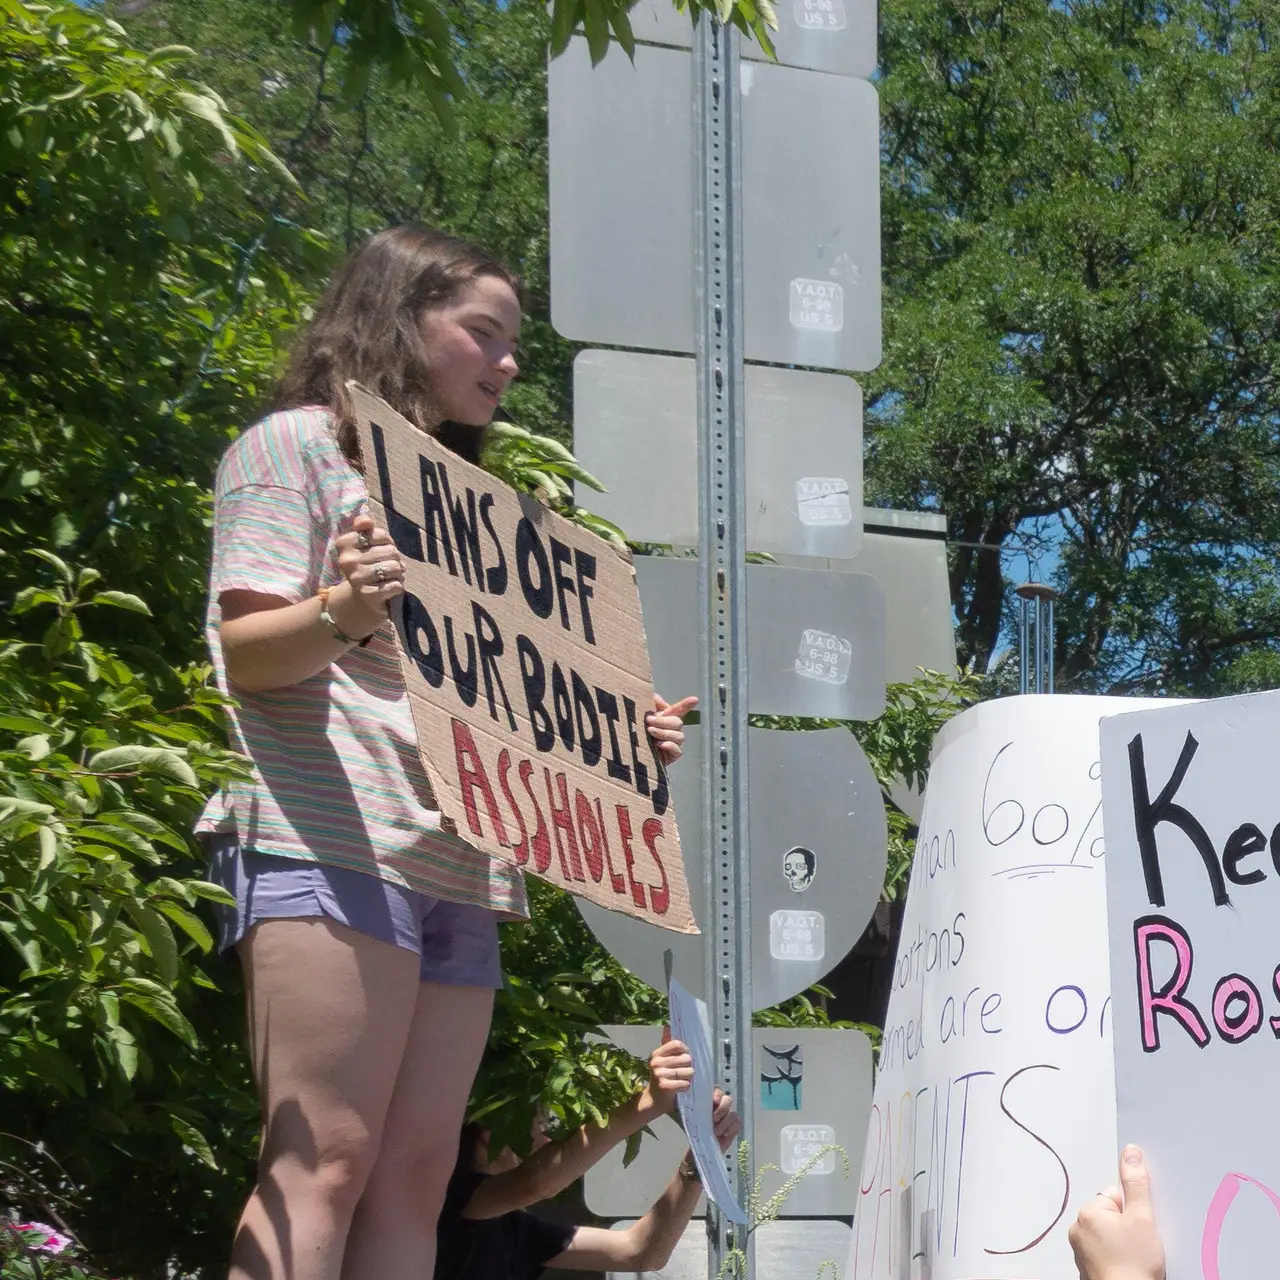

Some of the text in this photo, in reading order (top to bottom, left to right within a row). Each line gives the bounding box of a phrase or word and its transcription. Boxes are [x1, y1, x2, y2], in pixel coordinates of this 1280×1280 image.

[800, 311, 820, 324] US
[369, 420, 597, 646] LAWS OFF
[402, 591, 670, 816] OUR BODIES
[451, 717, 670, 915] ASSHOLES
[940, 987, 1002, 1044] are
